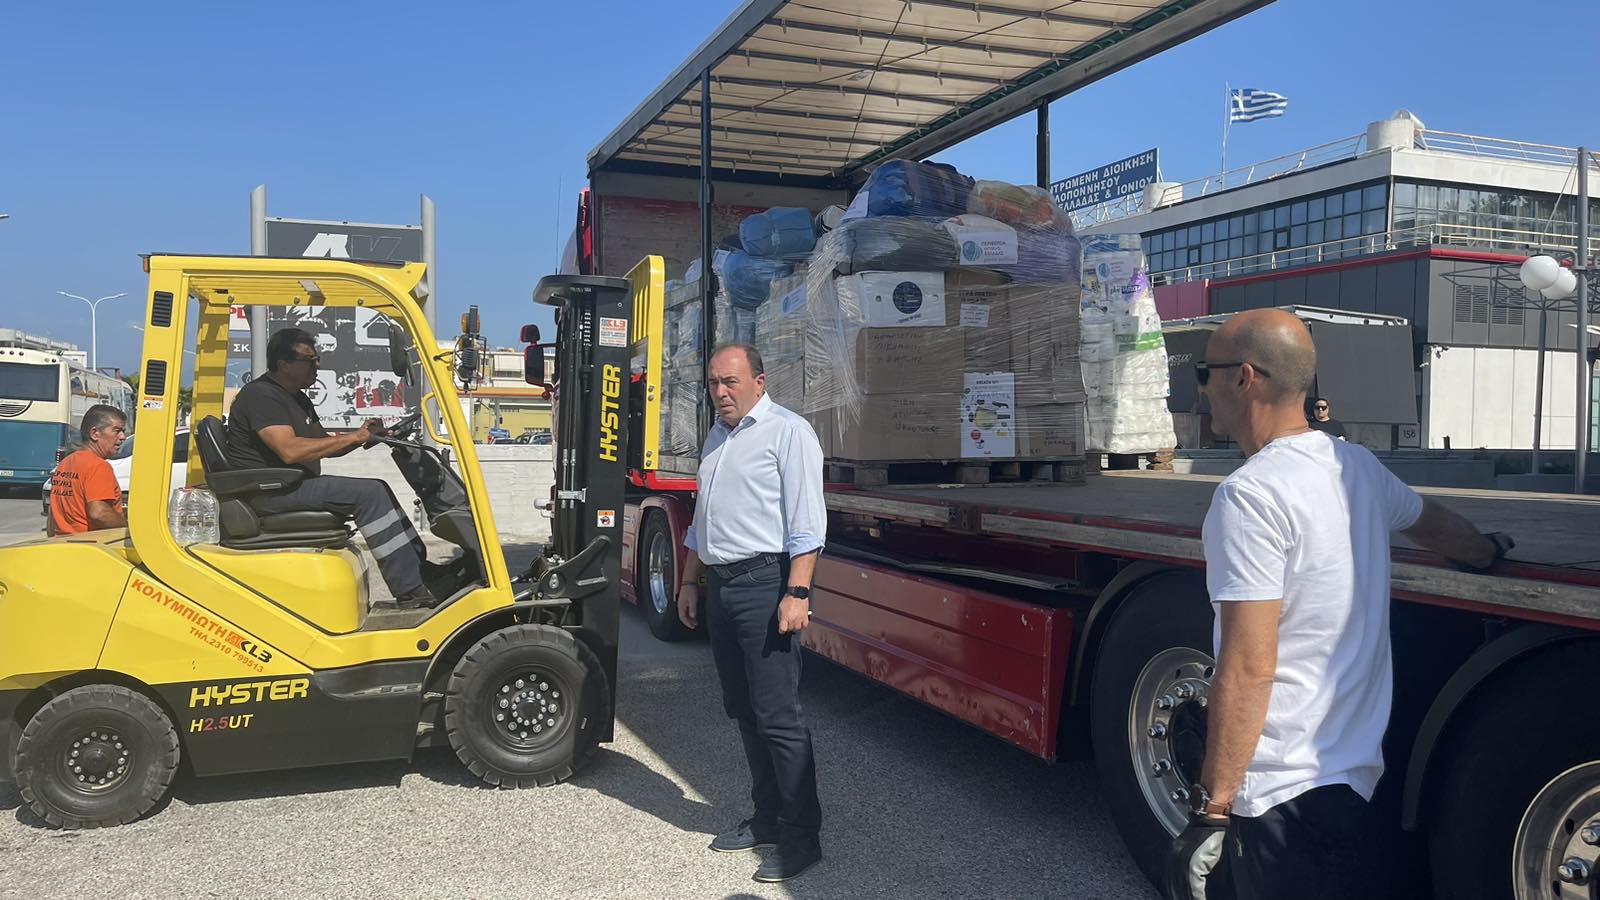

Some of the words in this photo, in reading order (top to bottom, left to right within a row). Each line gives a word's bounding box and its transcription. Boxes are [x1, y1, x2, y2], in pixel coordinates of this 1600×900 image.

[1103, 152, 1153, 178] ΔΙΟΙΚΗΣΗ
[1105, 189, 1111, 199] &
[599, 363, 621, 462] HYSTER
[131, 578, 227, 638] ΚΟΛΥΜΠΙΩΤΗ
[232, 650, 264, 673] 799513
[189, 678, 310, 708] HYSTER
[189, 713, 254, 733] H2.5UT
